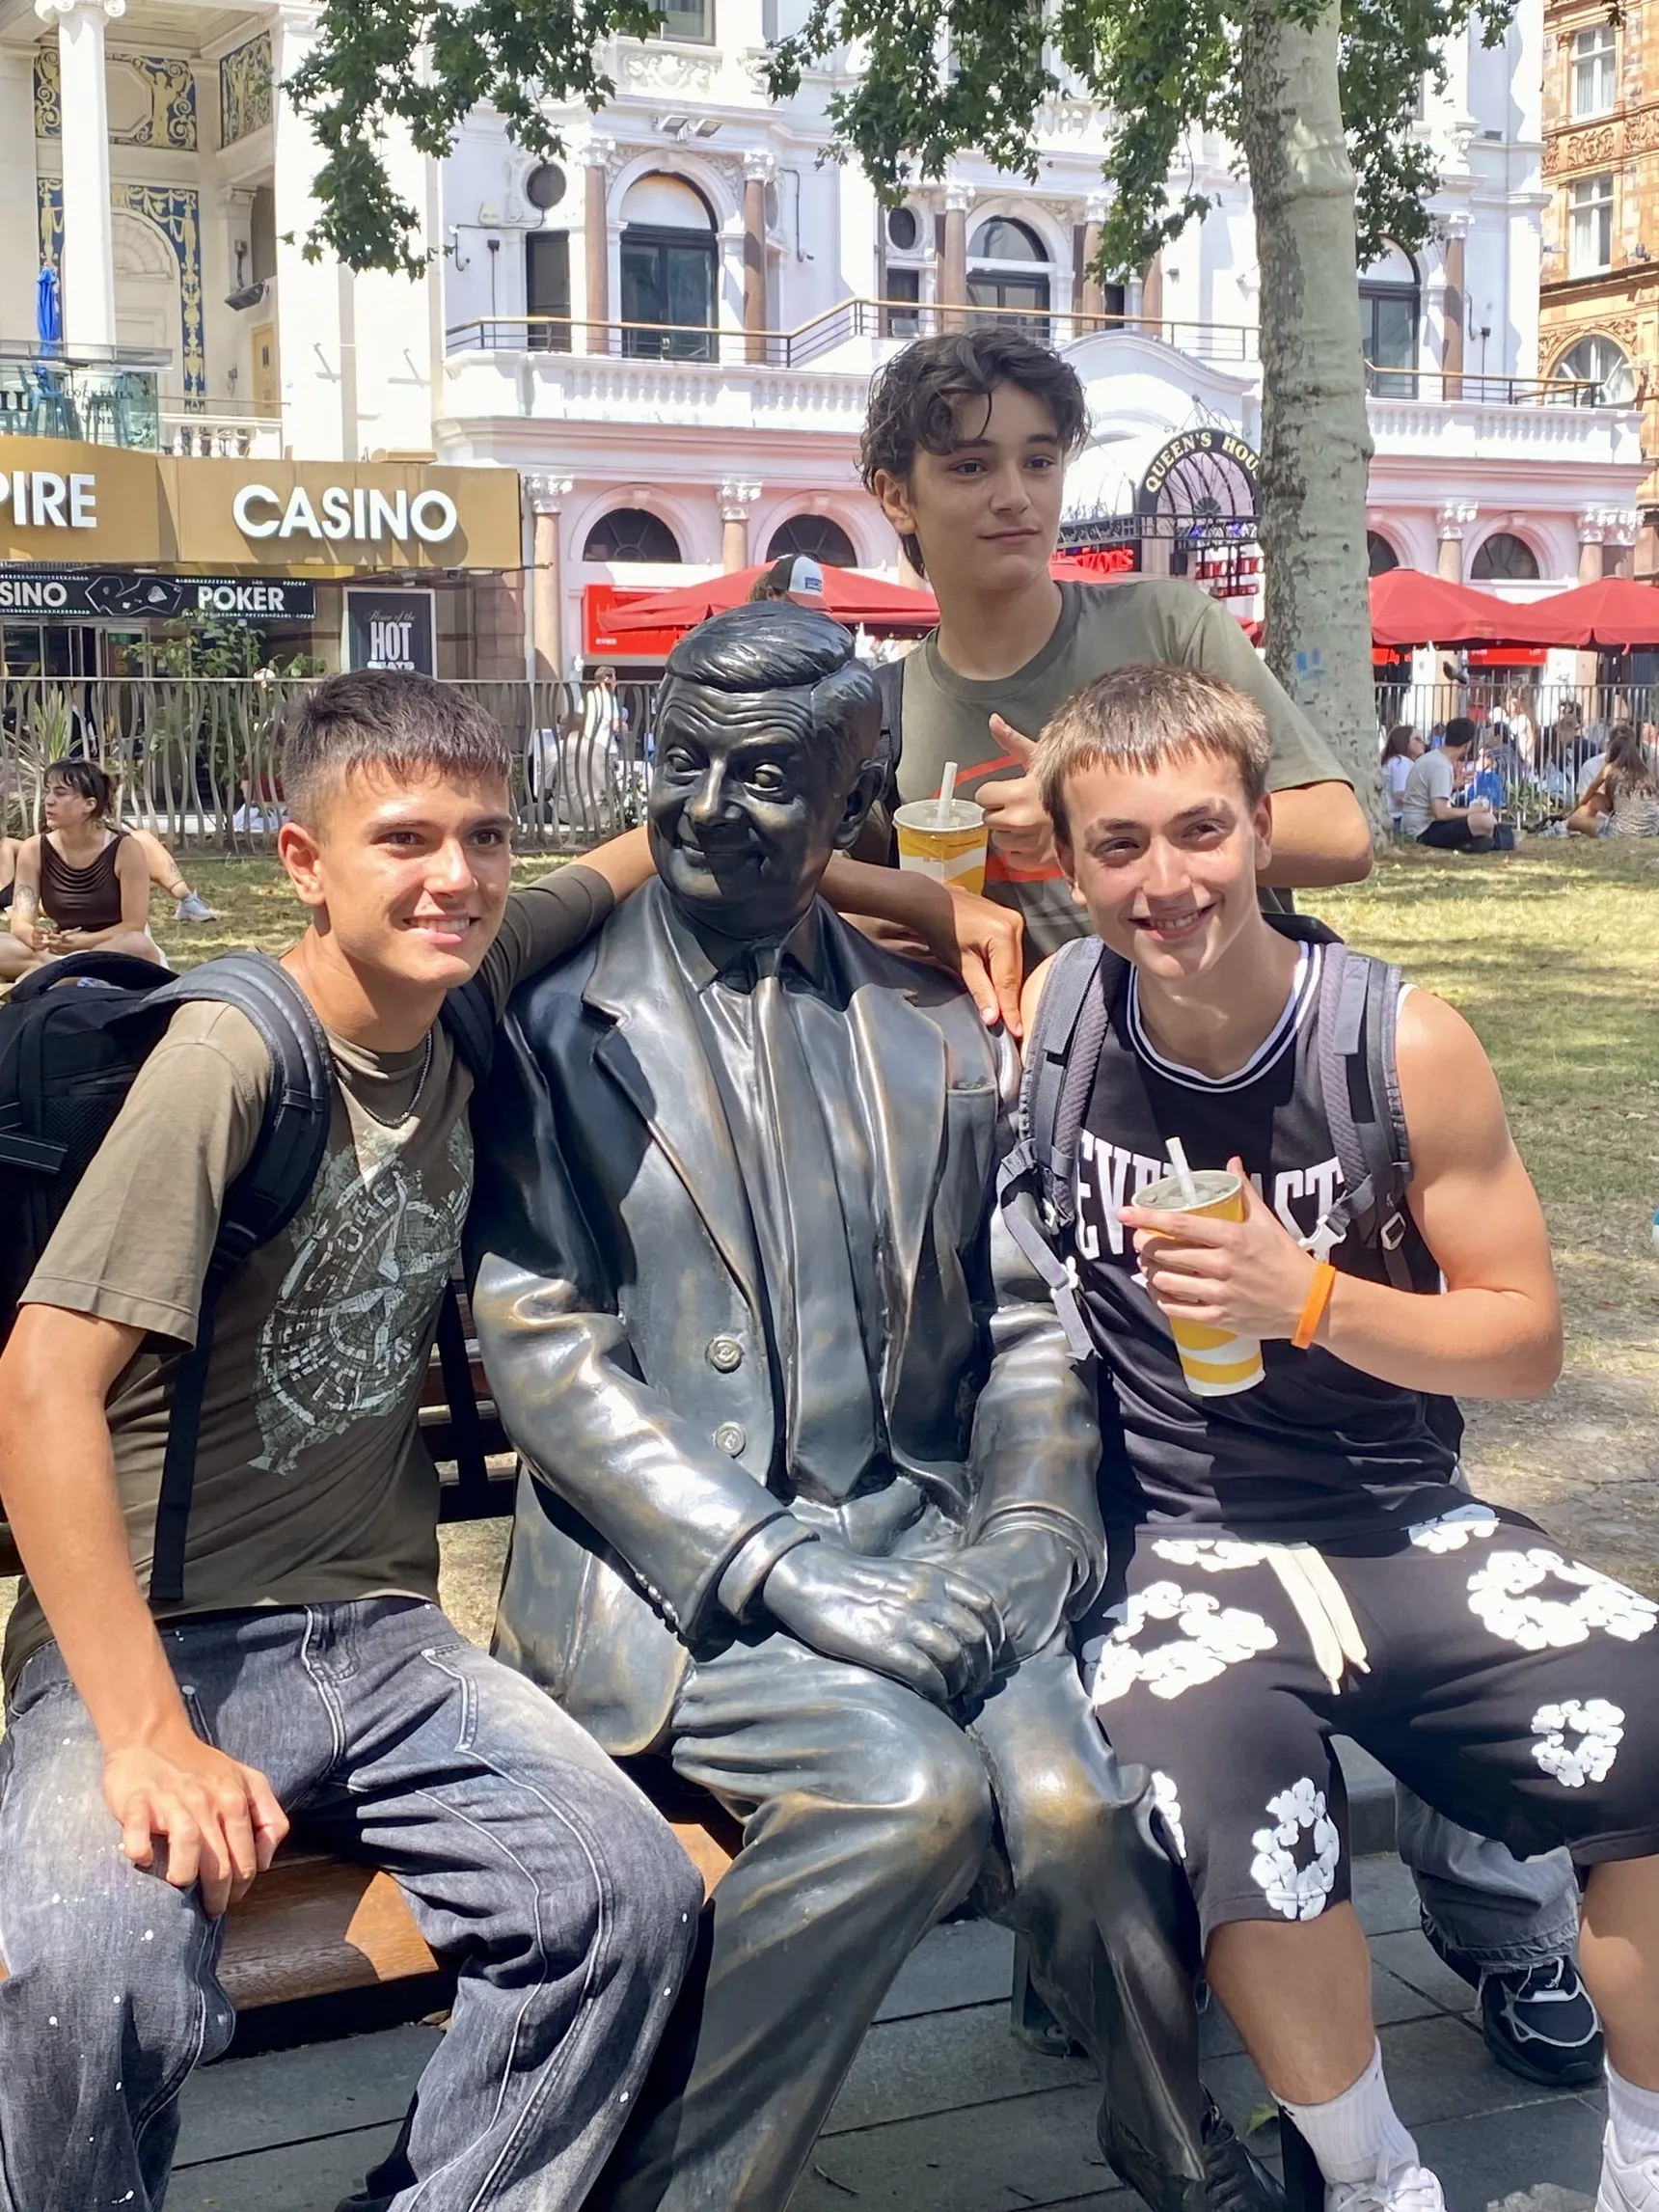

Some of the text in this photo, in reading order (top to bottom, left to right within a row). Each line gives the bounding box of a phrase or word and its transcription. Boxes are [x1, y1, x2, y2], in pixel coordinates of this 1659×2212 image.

[1146, 431, 1212, 493] QUEEN'S
[233, 484, 458, 543] CASINO
[0, 581, 68, 607] SINO
[199, 587, 286, 612] POKER
[370, 621, 413, 661] HOT
